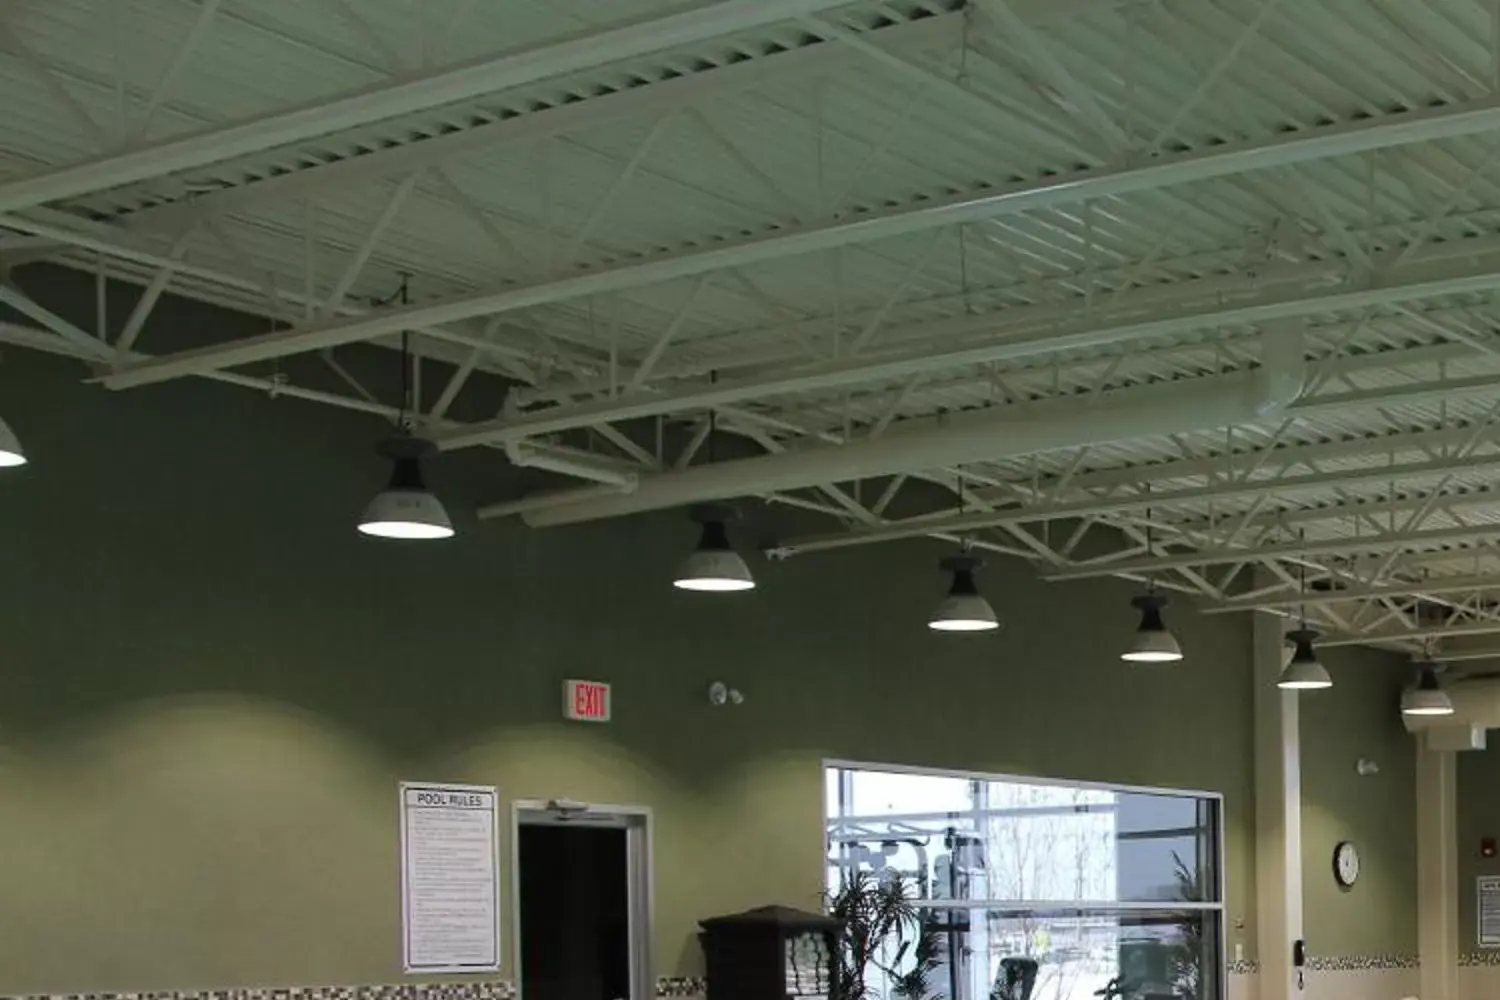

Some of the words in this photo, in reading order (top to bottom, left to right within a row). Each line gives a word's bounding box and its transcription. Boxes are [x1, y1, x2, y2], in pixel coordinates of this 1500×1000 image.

[575, 683, 608, 716] EXIT
[417, 792, 447, 805] POOL
[449, 794, 482, 807] RULES
